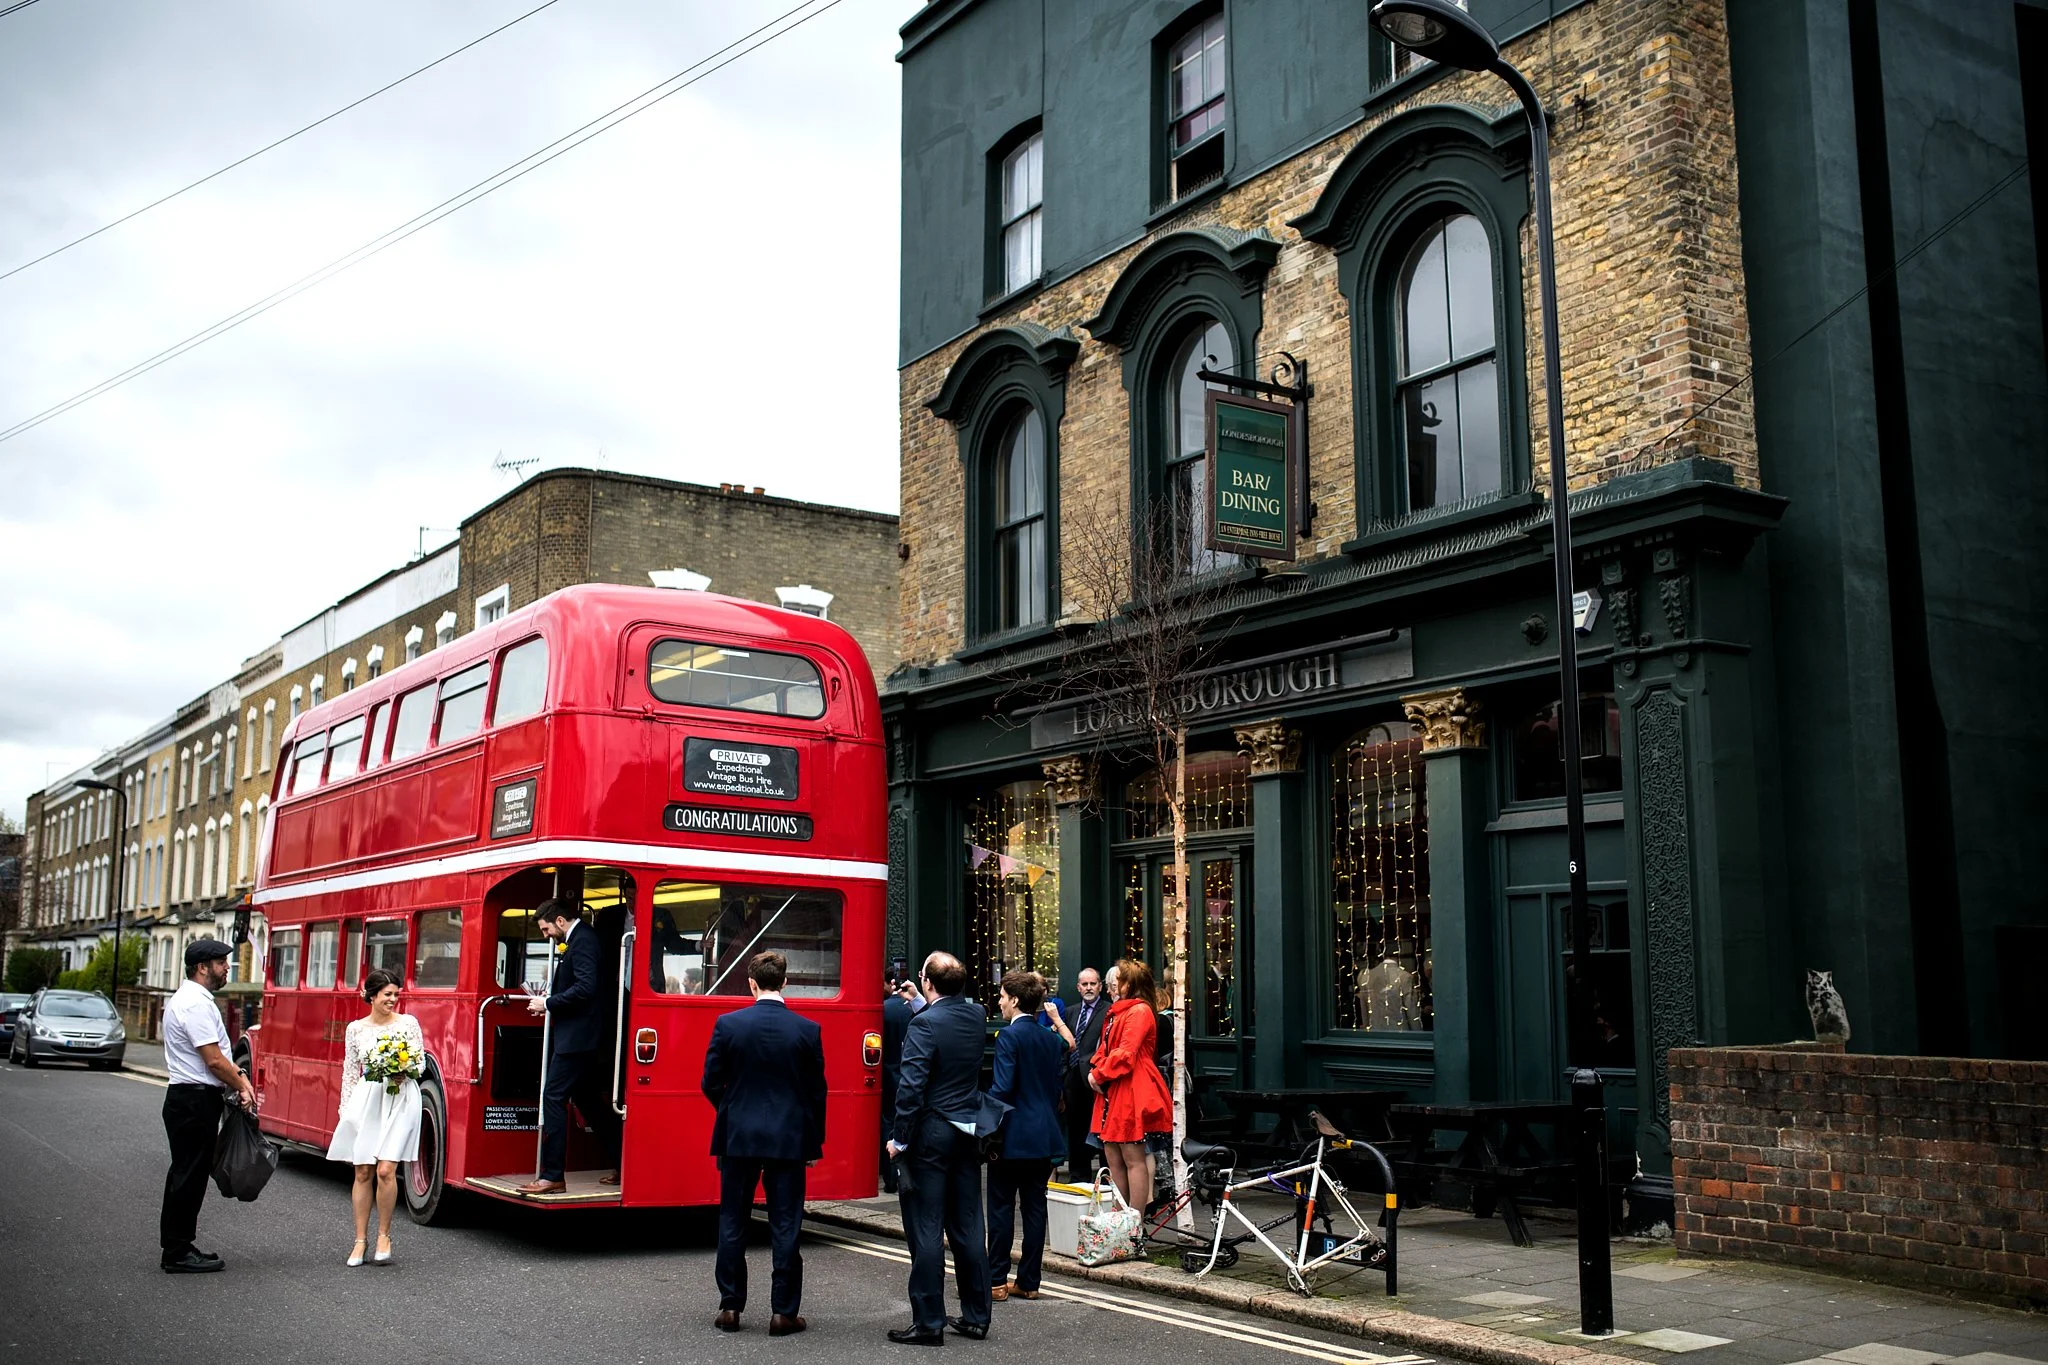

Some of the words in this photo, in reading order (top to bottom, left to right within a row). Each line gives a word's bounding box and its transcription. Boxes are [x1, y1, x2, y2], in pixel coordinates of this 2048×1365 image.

[1221, 429, 1284, 448] LONDESBOROUGH
[1232, 469, 1271, 491] BAR/
[1221, 490, 1281, 516] DINING
[1072, 653, 1339, 735] LONDBOROUGH
[717, 750, 764, 765] PRIVATE
[716, 762, 764, 775] Expeditional
[707, 771, 737, 783] Vintage
[739, 774, 754, 783] Bus
[756, 775, 772, 786] Hire
[694, 781, 785, 796] www.expeditional.co.uk
[674, 808, 798, 835] CONGRATULATIONS
[1569, 860, 1577, 874] 6
[1326, 1240, 1334, 1253] P
